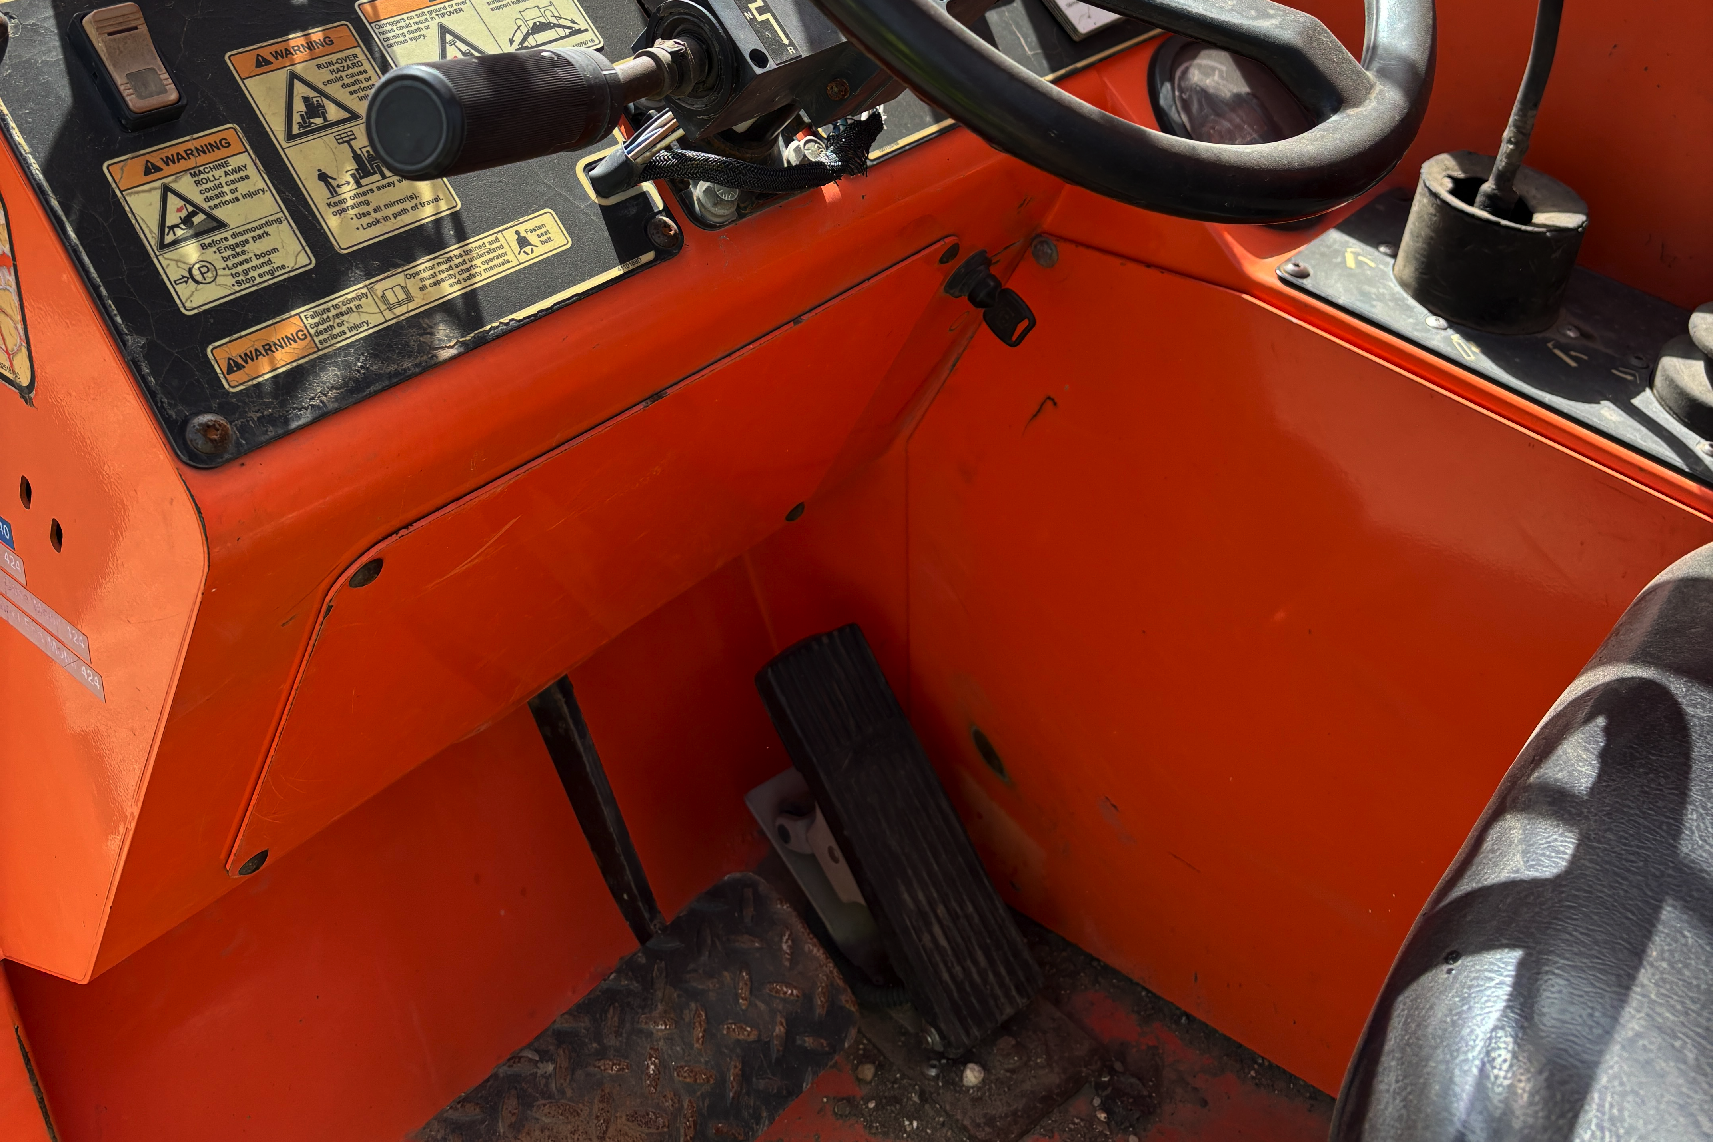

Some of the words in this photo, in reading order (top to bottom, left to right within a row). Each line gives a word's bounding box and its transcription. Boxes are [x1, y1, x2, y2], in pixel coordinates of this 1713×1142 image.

[374, 18, 406, 29] Outriggers
[427, 5, 447, 16] ground
[436, 7, 464, 19] TIPOVER
[270, 36, 334, 61] WARNING
[788, 46, 796, 55] R
[316, 53, 360, 71] RUN-OVER
[329, 60, 364, 76] HAZARD
[323, 76, 344, 87] could
[345, 70, 368, 80] cause
[341, 78, 363, 90] death
[160, 137, 231, 167] WARNING
[189, 160, 231, 179] MACHINE
[194, 175, 223, 187] ROLL-
[224, 164, 248, 178] AWAY
[199, 183, 224, 195] could
[225, 174, 250, 186] cause
[204, 191, 228, 203] death
[229, 187, 239, 195] or
[208, 197, 241, 211] serious
[241, 187, 268, 202] injury.
[327, 198, 348, 209] Keep
[350, 189, 375, 201] others
[376, 182, 396, 192] away
[354, 211, 372, 220] Use
[373, 205, 383, 214] all
[383, 192, 420, 210] mirror(s).
[332, 200, 372, 217] operating.
[361, 219, 382, 230] Look
[392, 206, 410, 220] path
[410, 202, 419, 211] of
[420, 195, 444, 207] travel.
[200, 236, 230, 251] Before
[230, 216, 285, 241] dismounting:
[251, 231, 271, 244] park
[525, 223, 546, 235] Fasten
[537, 230, 551, 239] seat
[540, 236, 553, 245] belt.
[255, 246, 280, 259] boom
[405, 263, 435, 280] Operator
[436, 257, 452, 267] must
[454, 251, 463, 260] be
[463, 242, 487, 256] trained
[488, 236, 500, 246] and
[231, 270, 241, 279] to
[241, 259, 275, 278] ground.
[257, 264, 290, 280] engine.
[418, 282, 427, 292] all
[429, 273, 457, 289] capacity
[457, 263, 480, 276] charts,
[481, 251, 508, 266] operator
[419, 272, 437, 283] must
[438, 265, 453, 276] read
[455, 259, 467, 269] and
[468, 244, 505, 264] understand
[448, 279, 462, 288] and
[462, 271, 483, 283] safety
[484, 260, 513, 273] manuals.
[304, 308, 331, 322] Failure
[341, 291, 369, 306] comply
[309, 318, 331, 330] could
[331, 309, 353, 320] result
[314, 326, 335, 338] death
[337, 320, 346, 328] or
[318, 332, 347, 346] serious
[347, 321, 372, 335] injury.
[238, 329, 308, 366] WARNING
[82, 666, 100, 690] 424
